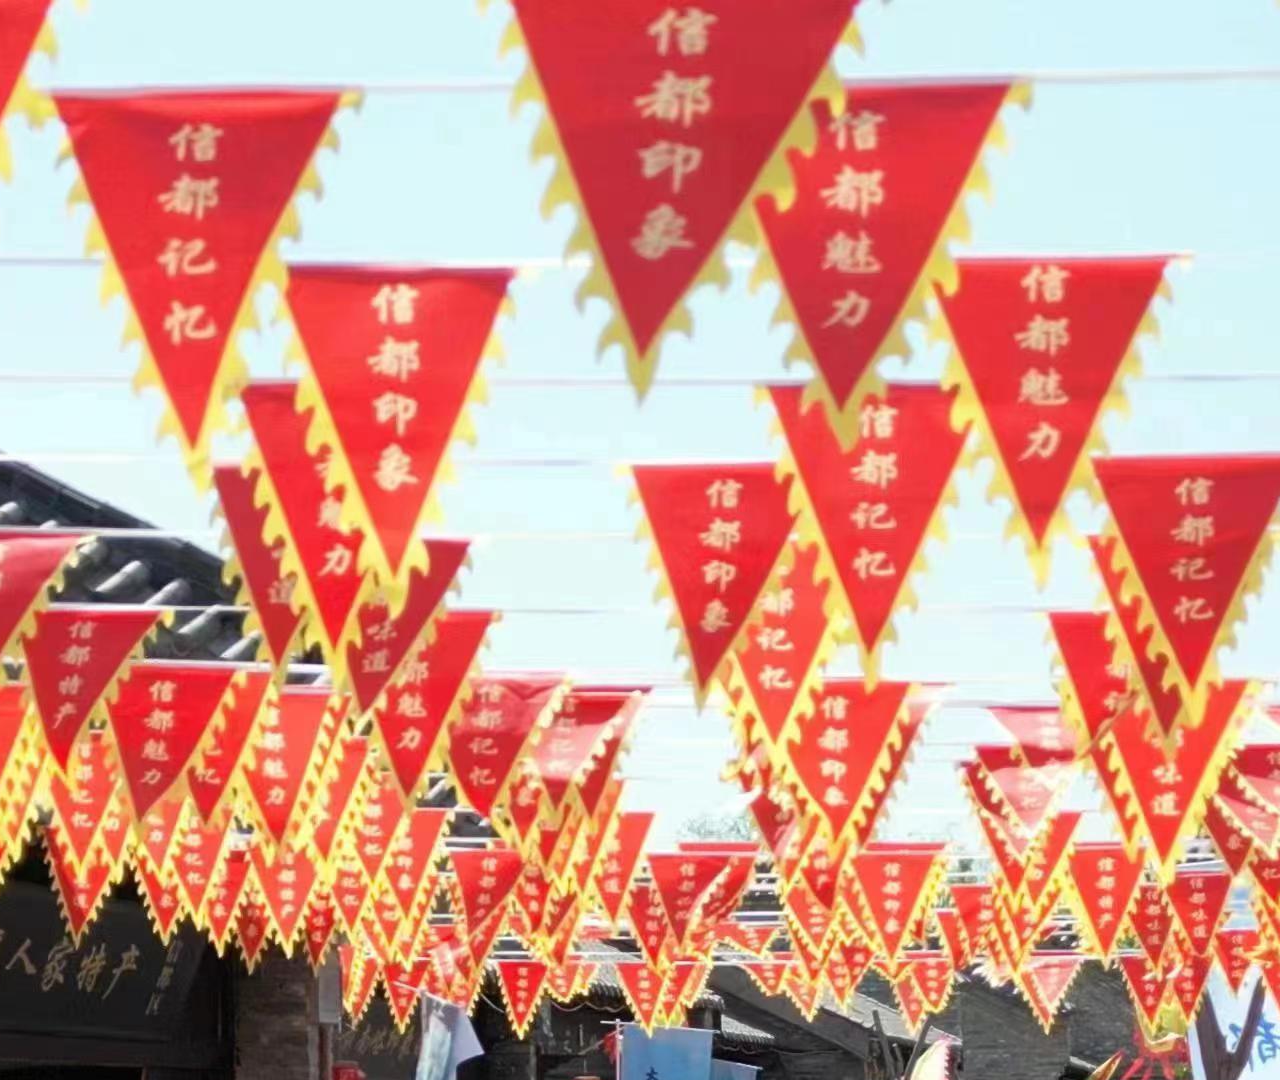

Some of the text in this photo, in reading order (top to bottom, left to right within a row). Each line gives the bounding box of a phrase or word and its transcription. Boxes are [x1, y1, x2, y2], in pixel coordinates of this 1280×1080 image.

[631, 8, 718, 260] 信都印象
[157, 123, 224, 345] 信都记忆
[820, 110, 885, 329] 信都魅力
[366, 283, 420, 491] 信都印象
[1015, 265, 1070, 461] 信都魅力
[699, 478, 744, 634] 信都印象
[850, 404, 898, 580] 信都记忆
[1169, 476, 1216, 624] 信都记忆
[53, 621, 98, 729] 信都特产
[396, 640, 429, 750] 都魅力
[755, 585, 794, 691] 都记忆
[140, 680, 178, 785] 信都魅力
[818, 696, 849, 807] 信都印象
